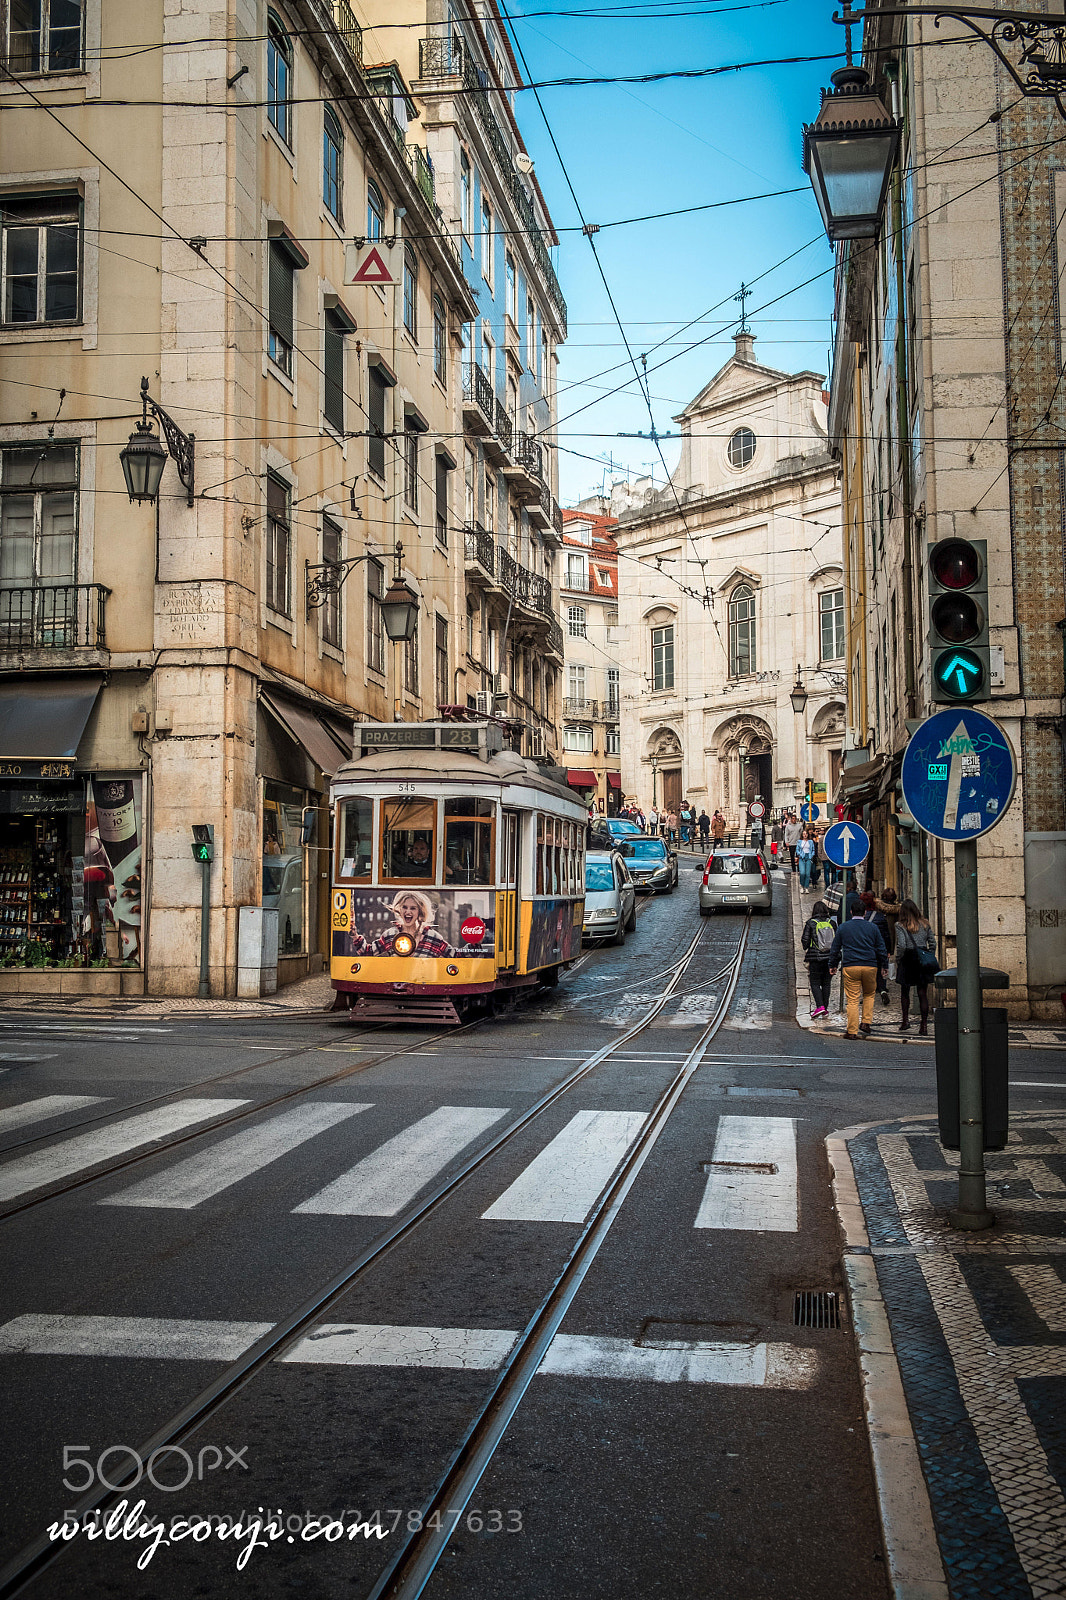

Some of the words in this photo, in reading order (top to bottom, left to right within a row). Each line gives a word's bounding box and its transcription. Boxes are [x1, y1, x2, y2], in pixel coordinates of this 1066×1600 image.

[365, 730, 428, 742] PRAZERES
[449, 730, 472, 744] 28
[398, 783, 416, 792] 545
[112, 818, 123, 827] 10
